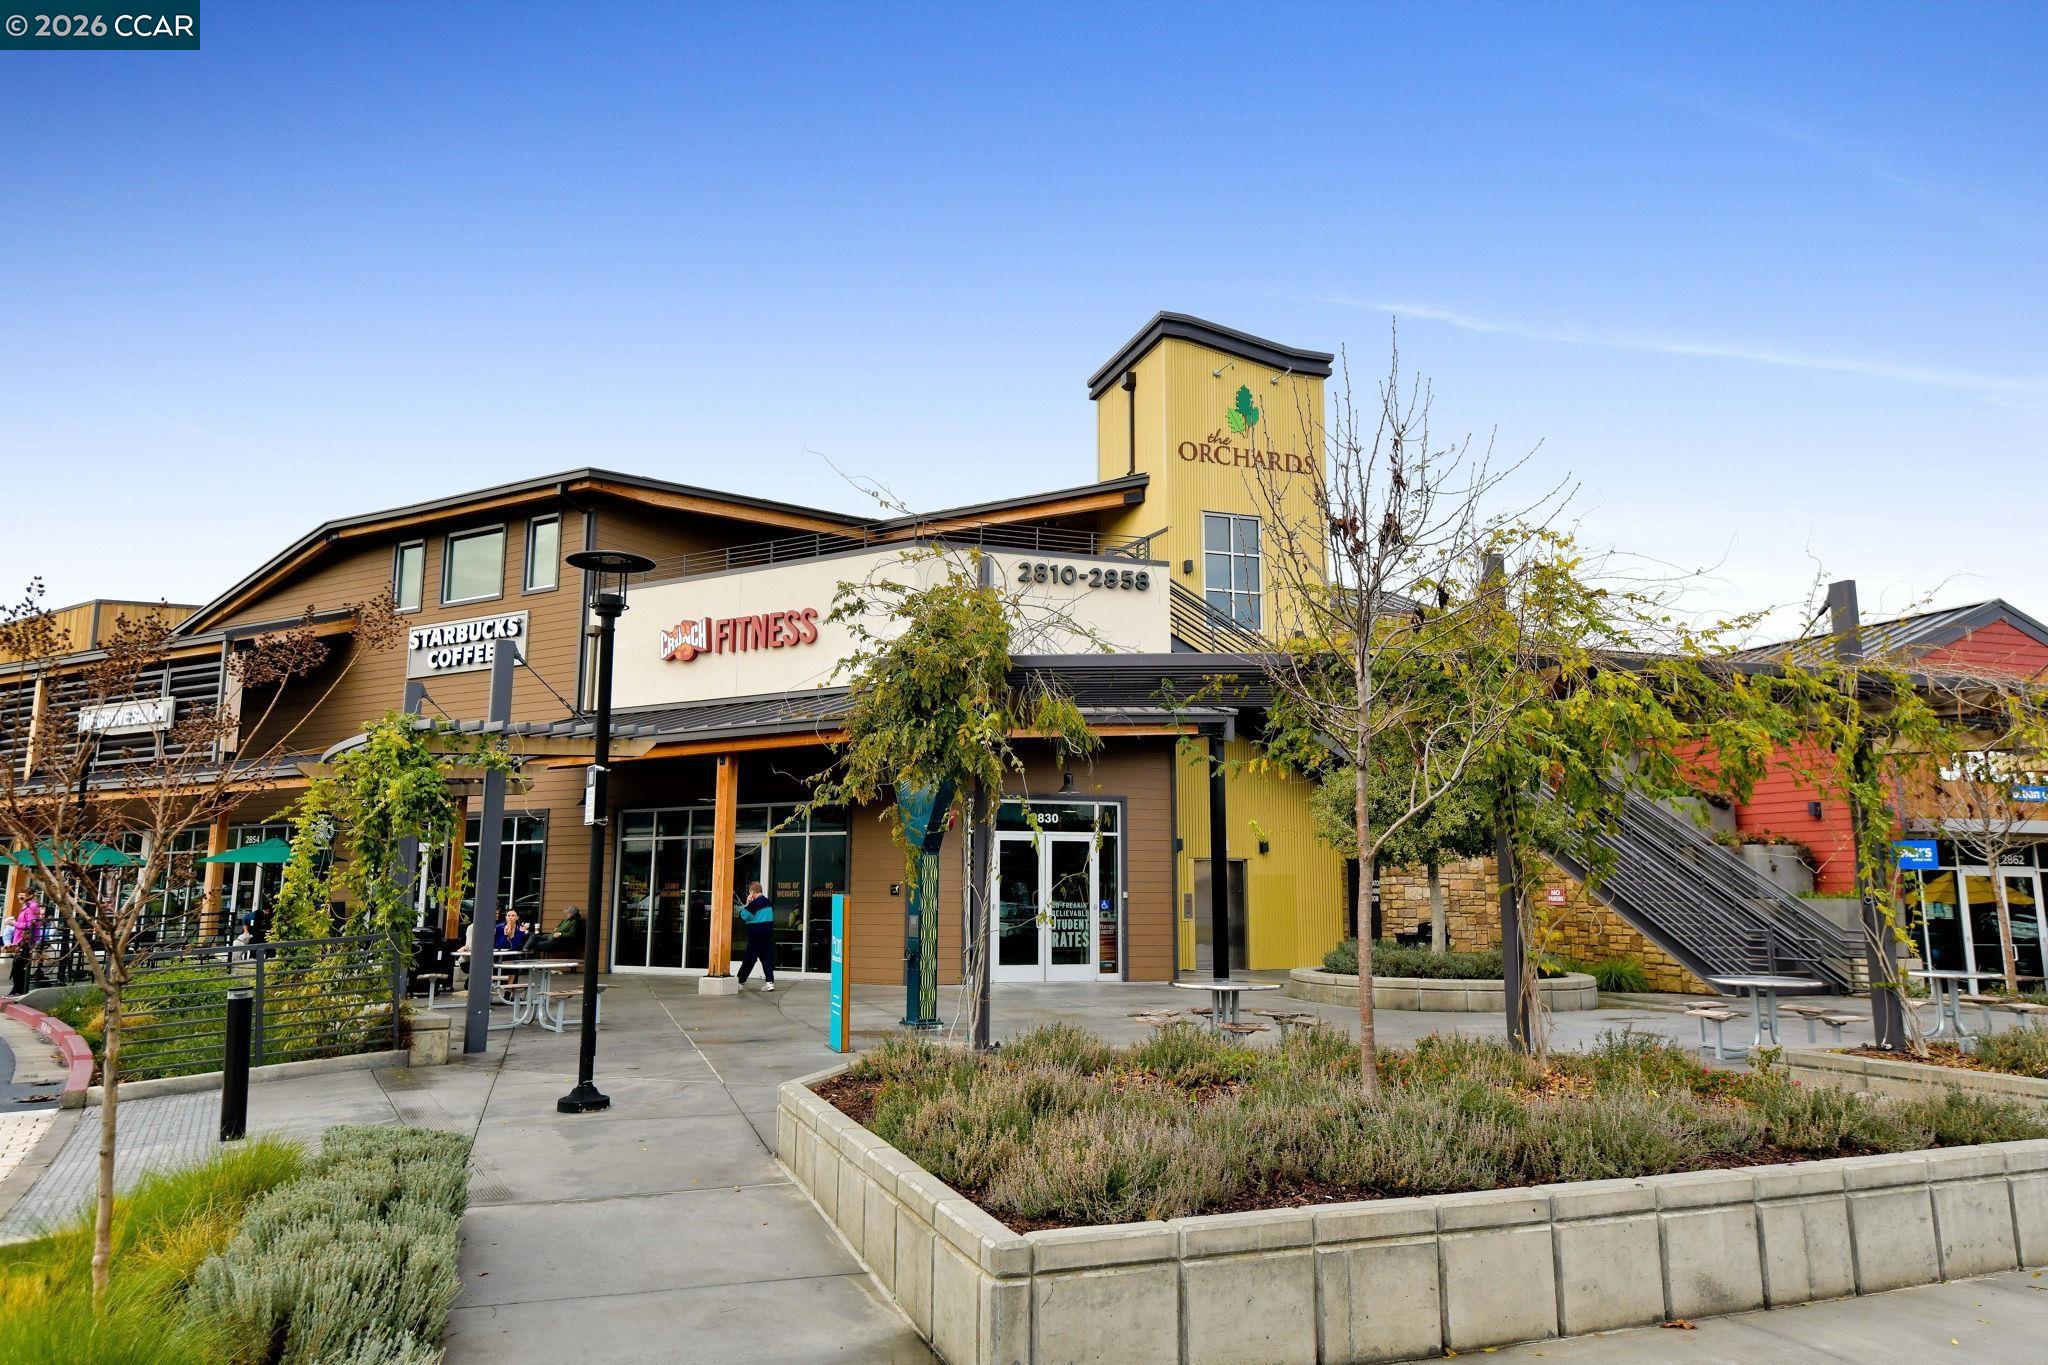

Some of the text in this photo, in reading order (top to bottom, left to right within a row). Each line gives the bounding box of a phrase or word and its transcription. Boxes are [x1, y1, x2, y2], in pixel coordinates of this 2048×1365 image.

[1207, 428, 1232, 446] the
[1178, 441, 1314, 475] ORCHARDS
[1018, 562, 1150, 591] 2810-2858
[409, 616, 520, 650] STARBUCKS
[715, 607, 818, 654] FITNESS
[427, 642, 495, 669] COFFEE
[1035, 813, 1059, 824] 830
[245, 835, 260, 844] 2854
[2002, 855, 2025, 865] 2862
[1052, 932, 1089, 947] RATES
